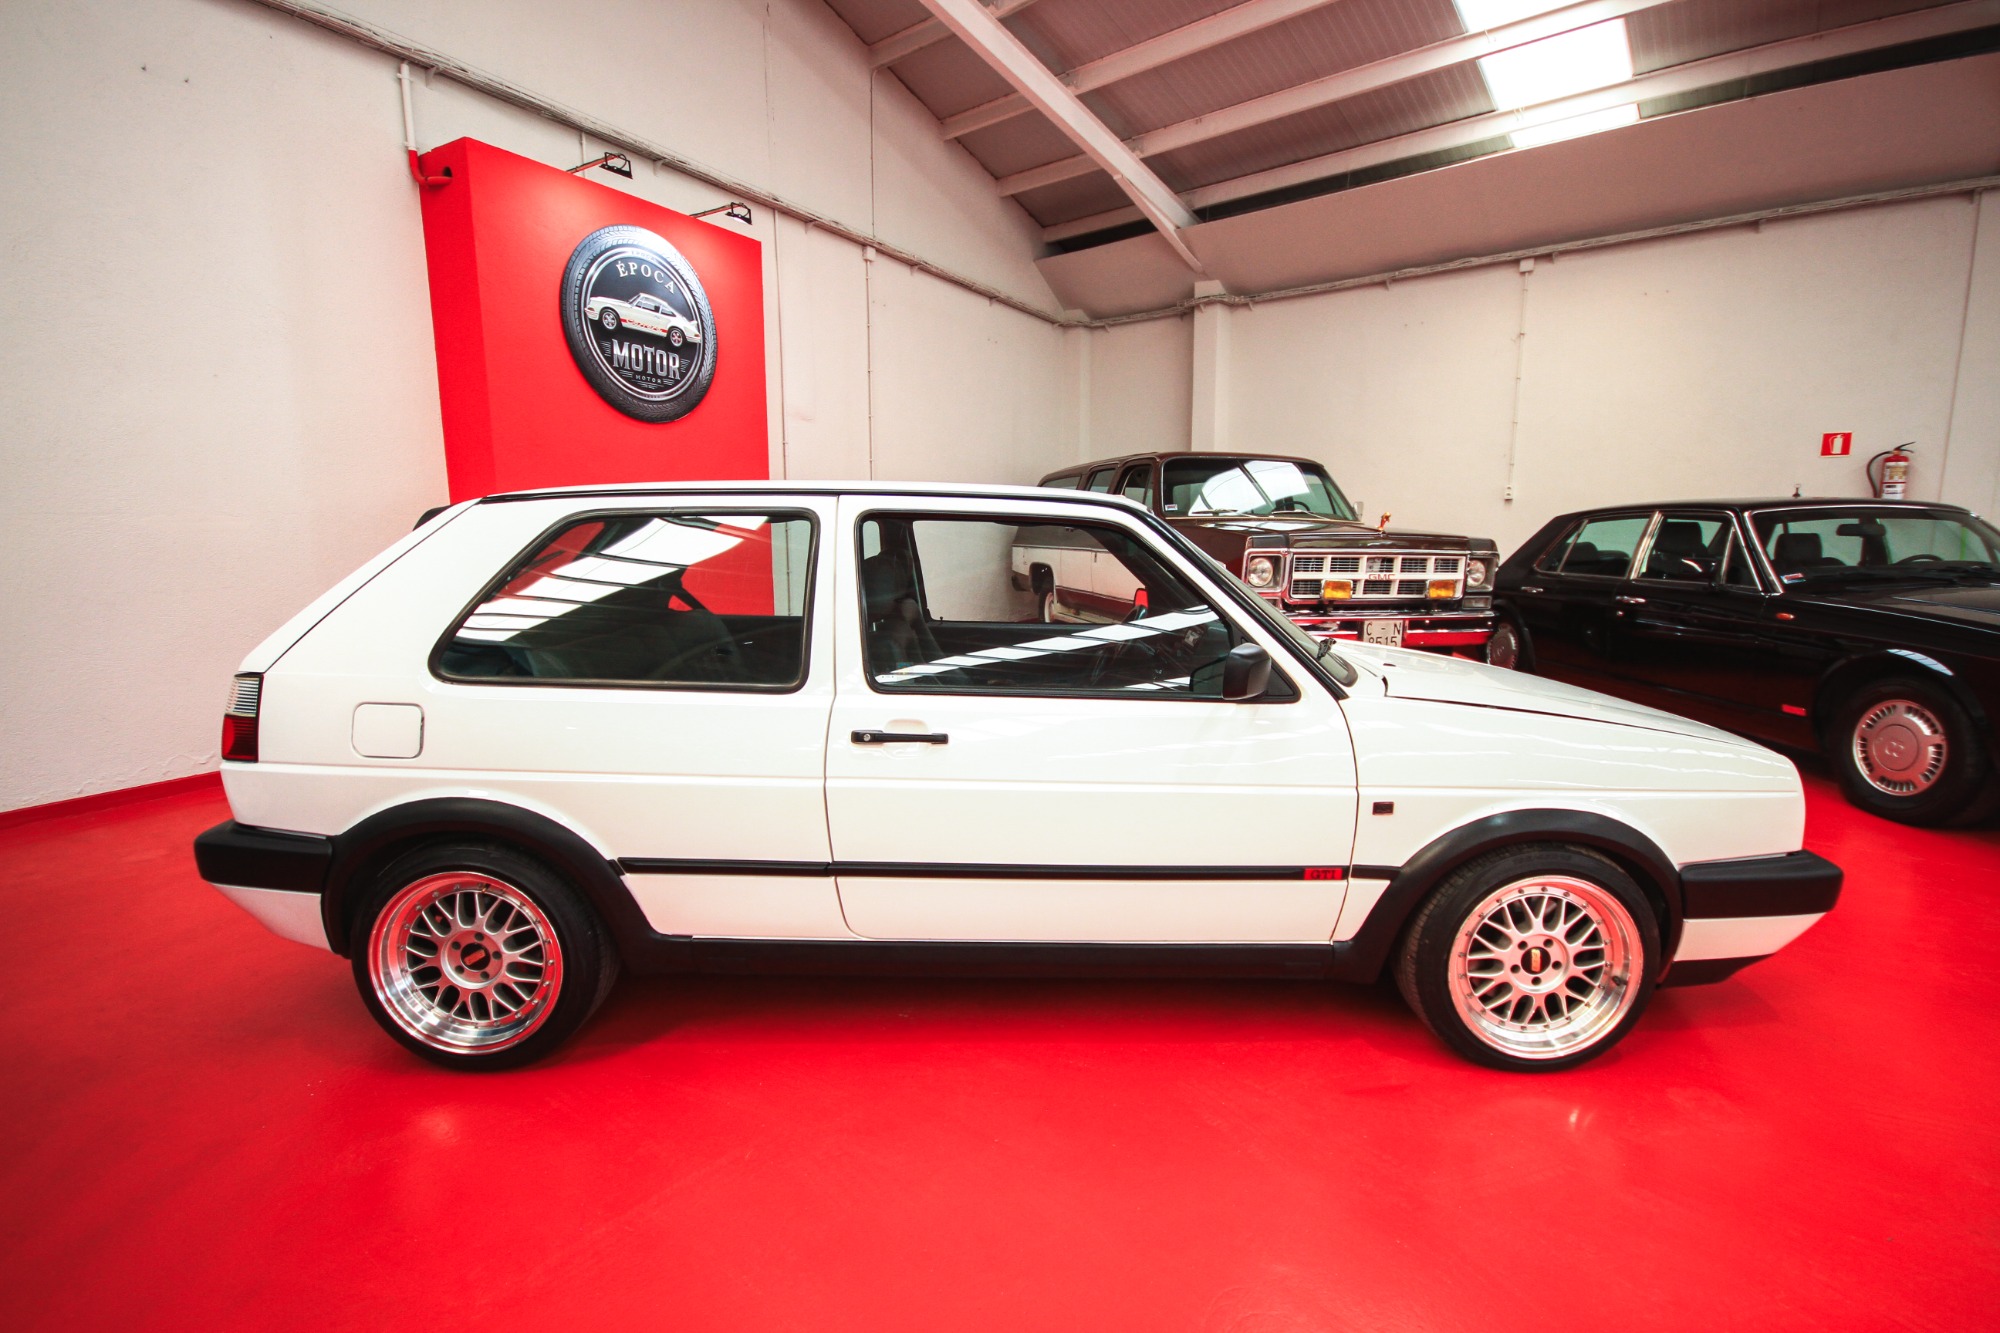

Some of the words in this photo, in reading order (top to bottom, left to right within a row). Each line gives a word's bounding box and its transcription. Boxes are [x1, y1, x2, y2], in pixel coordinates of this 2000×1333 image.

[616, 261, 675, 293] ÉPOCA
[612, 339, 681, 380] MOTOR
[635, 374, 662, 384] MOTOR
[1366, 622, 1373, 636] C
[1393, 622, 1401, 636] N
[1310, 869, 1335, 880] GTI
